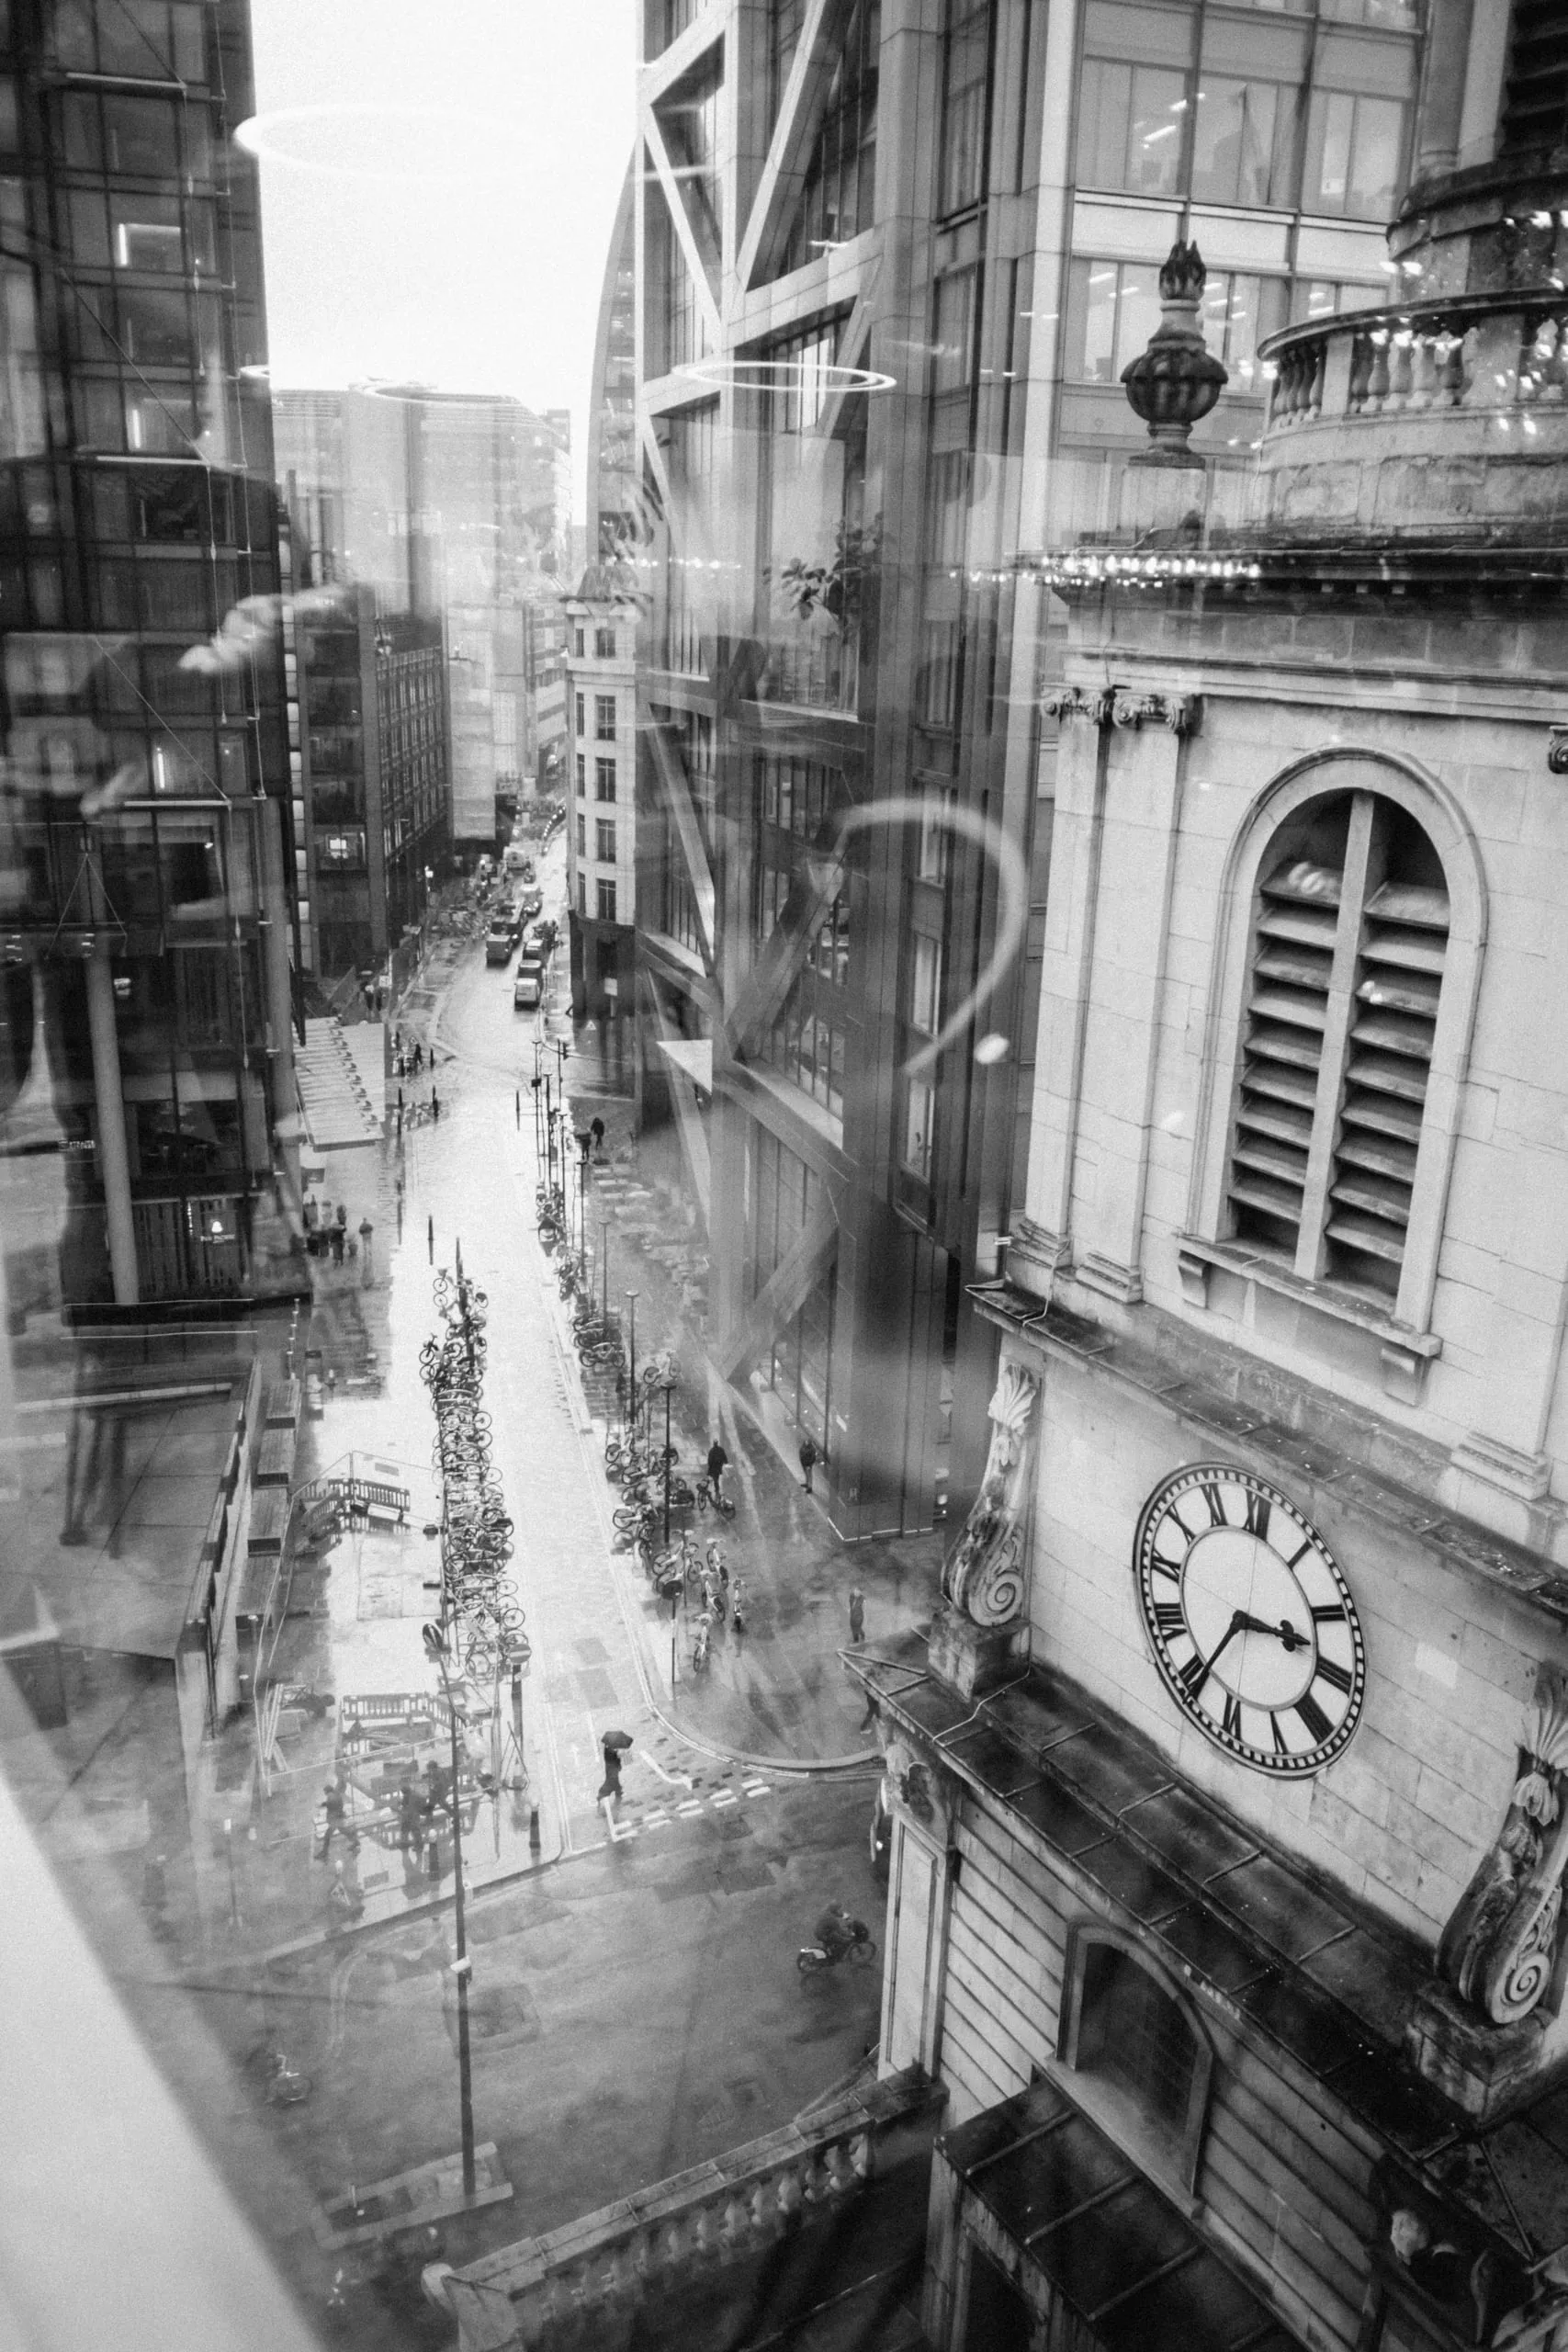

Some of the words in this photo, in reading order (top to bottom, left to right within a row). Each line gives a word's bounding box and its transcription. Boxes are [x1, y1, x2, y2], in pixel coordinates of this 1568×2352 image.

[1201, 1483, 1227, 1526] XI
[1244, 1486, 1272, 1541] XII
[1167, 1505, 1195, 1546] X
[1152, 1550, 1180, 1584] IX
[1289, 1542, 1313, 1567] I
[1312, 1605, 1348, 1621] II
[1317, 1657, 1353, 1697] III
[1223, 1692, 1241, 1741] VI
[1269, 1712, 1289, 1755] V
